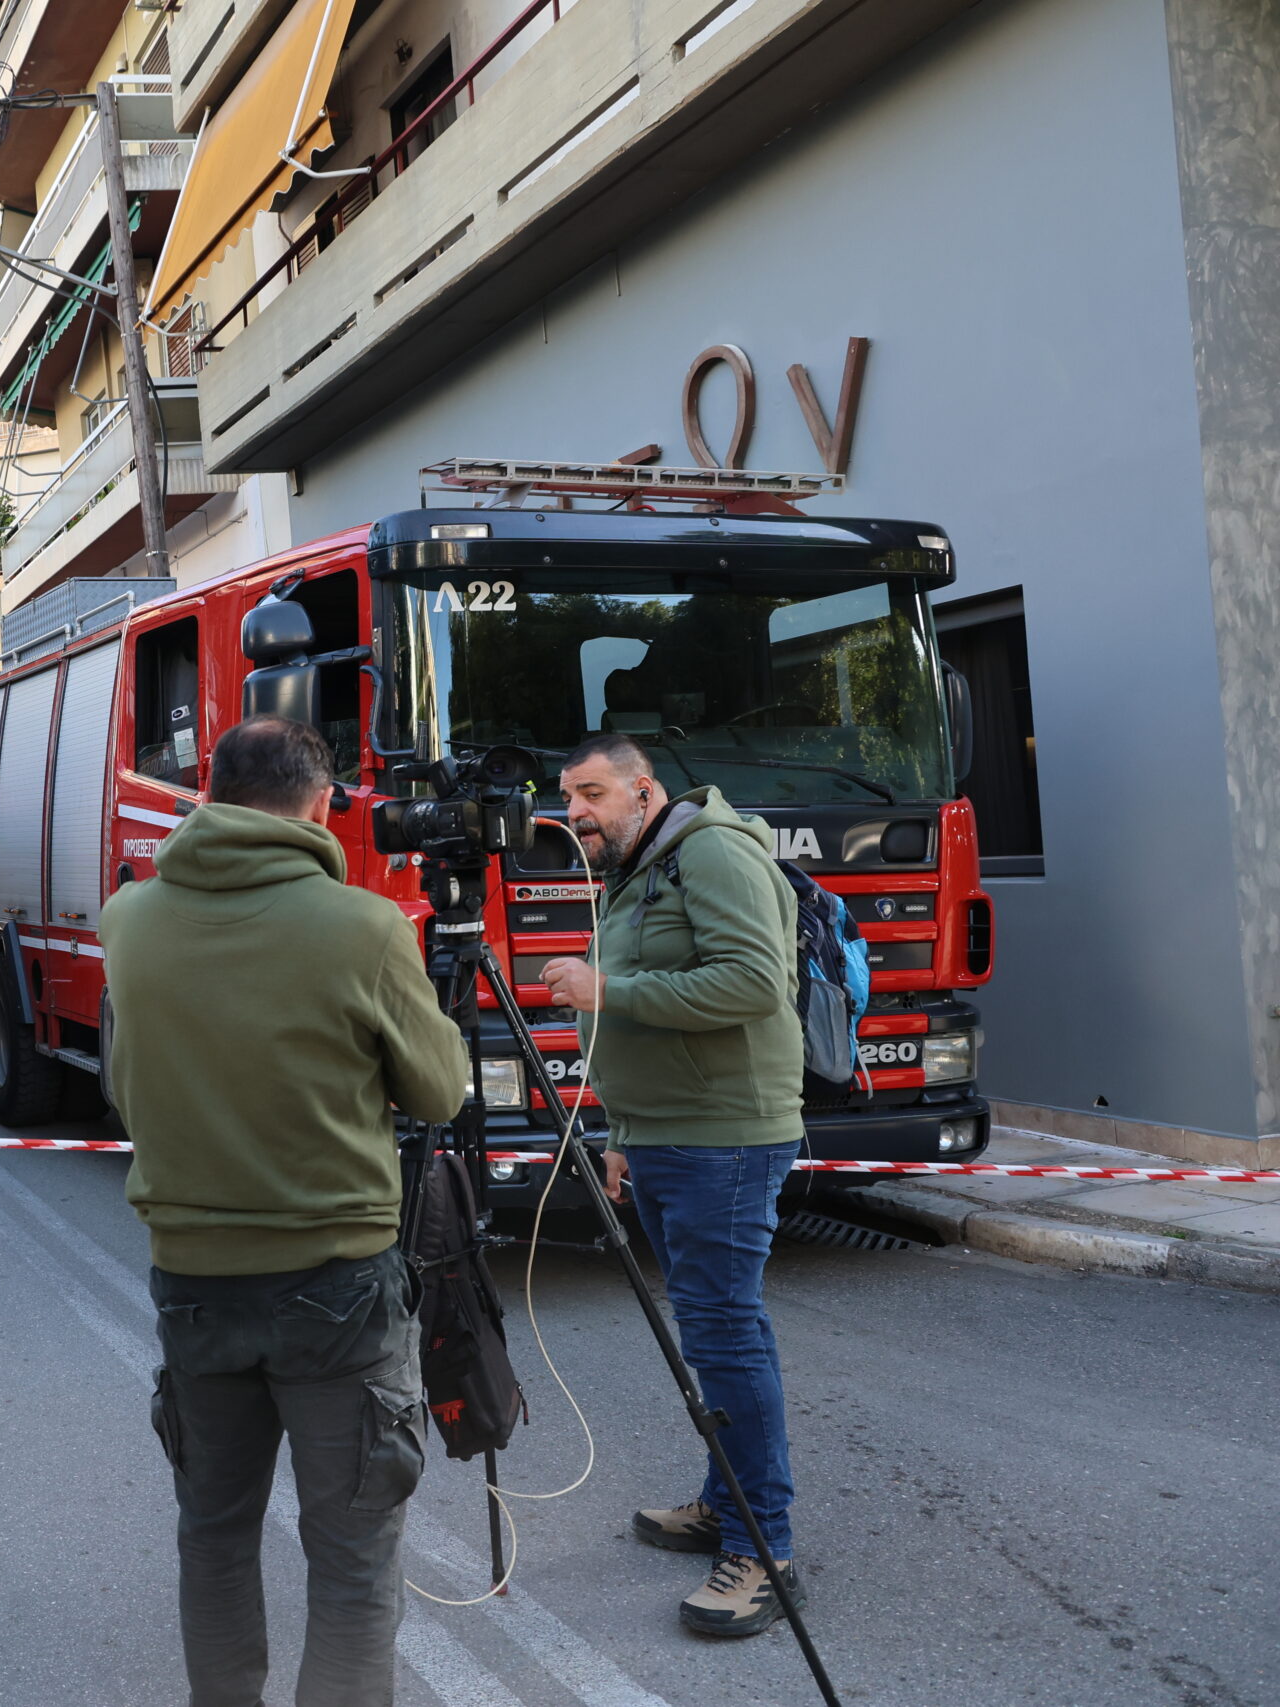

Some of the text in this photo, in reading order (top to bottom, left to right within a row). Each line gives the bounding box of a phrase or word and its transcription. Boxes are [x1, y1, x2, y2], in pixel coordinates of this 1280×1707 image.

[533, 888, 559, 897] ABO
[859, 1041, 918, 1064] 260
[545, 1059, 587, 1081] 94
